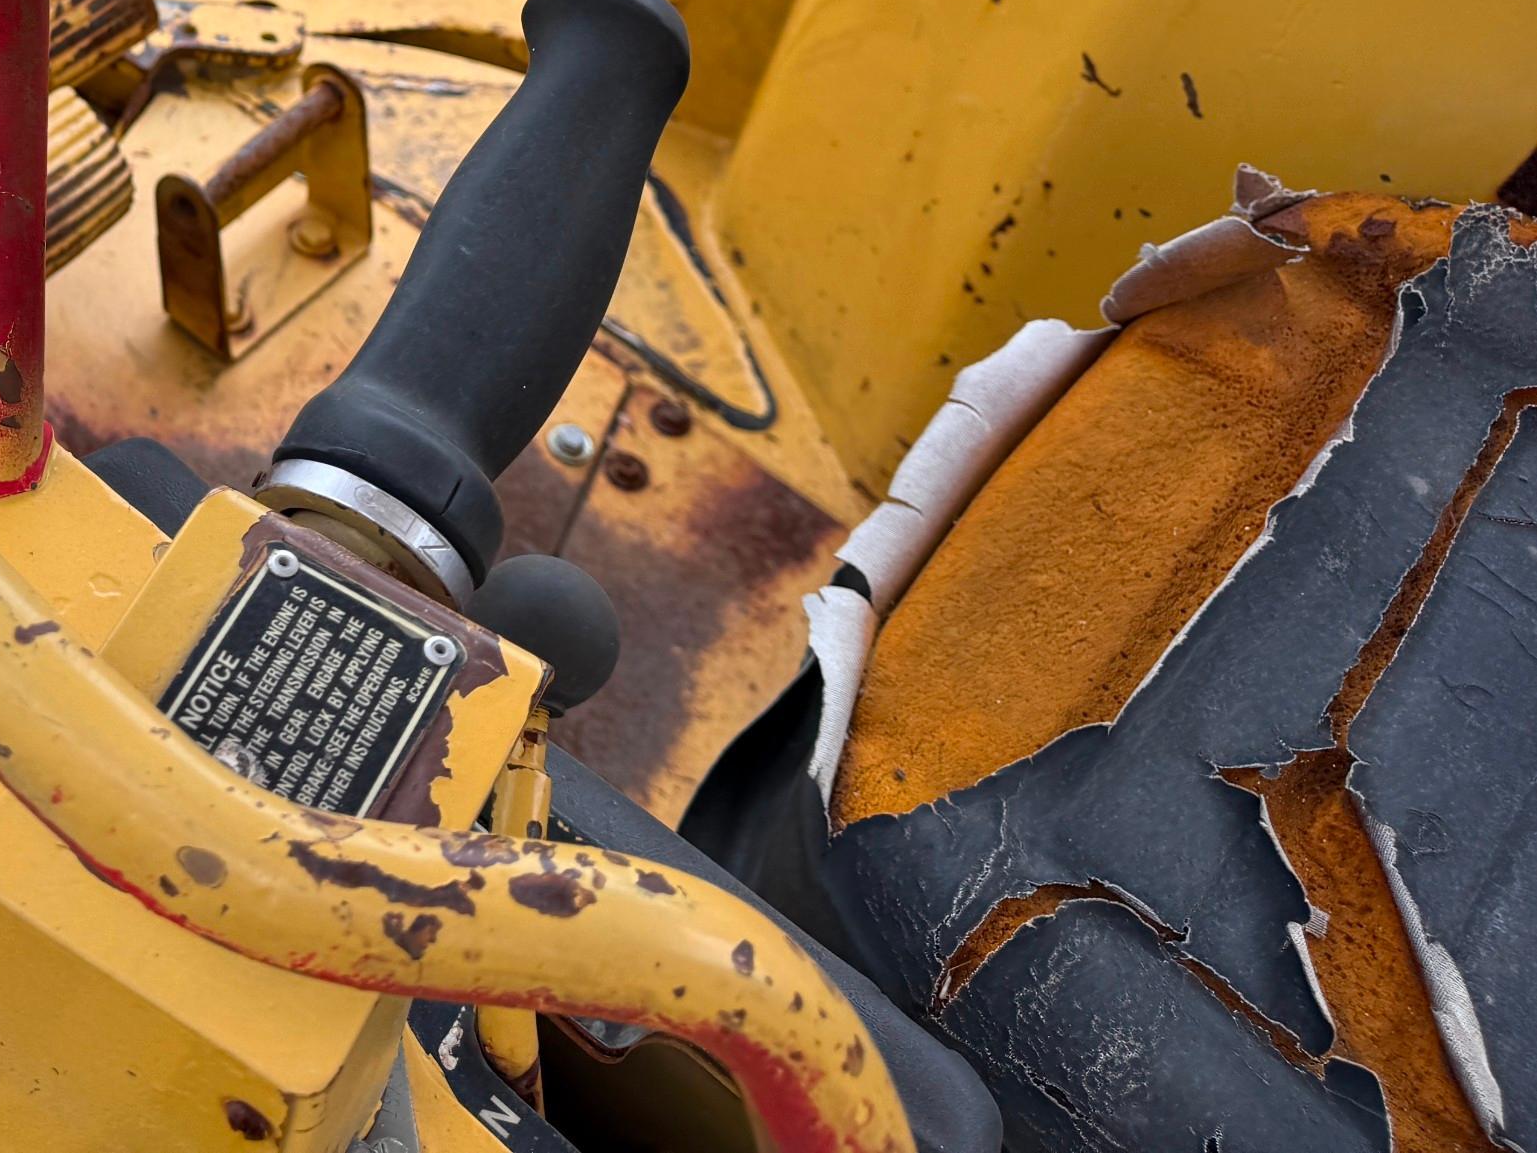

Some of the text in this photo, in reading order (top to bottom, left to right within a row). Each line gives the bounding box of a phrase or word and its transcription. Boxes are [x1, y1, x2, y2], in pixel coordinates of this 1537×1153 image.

[179, 650, 241, 730] NOTICE
[208, 692, 245, 729] TURN,
[234, 671, 252, 689] IF
[244, 645, 271, 672] THE
[261, 600, 300, 648] ENGINE
[290, 586, 309, 603] IS
[232, 596, 327, 734] THE STEERING LEVER IS
[247, 725, 274, 754] THE
[266, 627, 334, 720] TRANSMISSION
[327, 606, 347, 624] IN
[265, 616, 366, 770] IN GEAR. ENGAGE THE
[296, 638, 404, 809] BRAKE. SEE THE OPERATION
[305, 708, 337, 747] LOCK
[327, 687, 348, 710] BY
[341, 628, 385, 689] APPLYING
[344, 676, 410, 770] INSTRUCTIONS.
